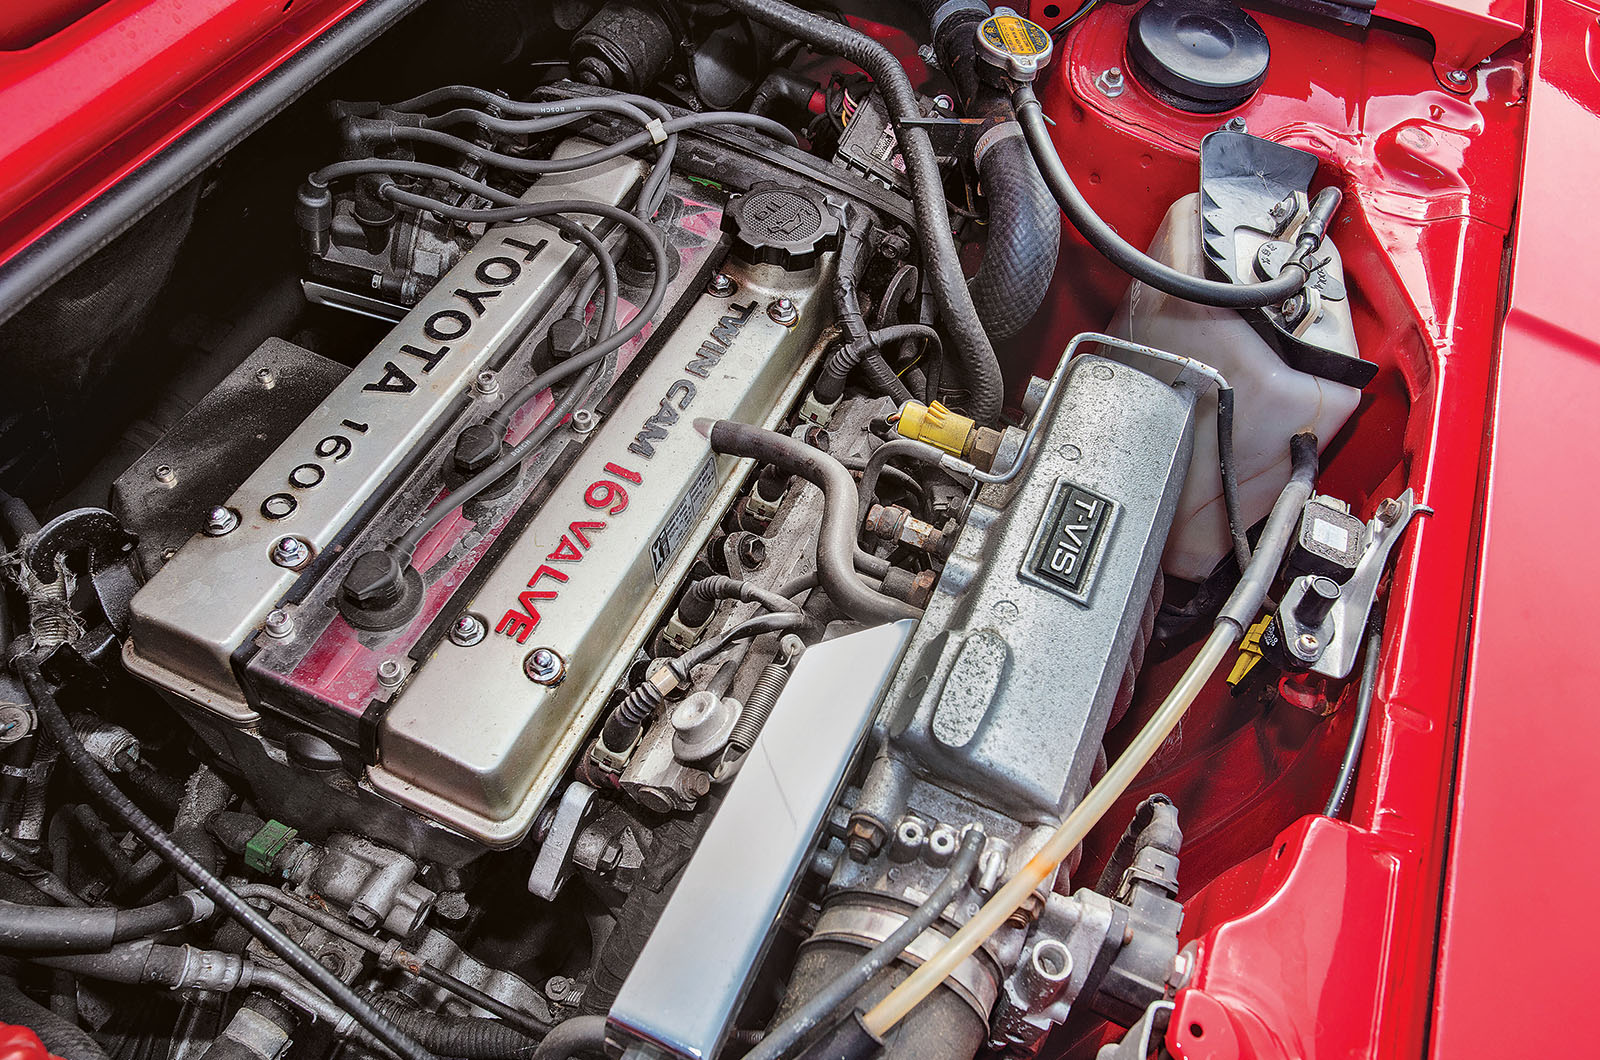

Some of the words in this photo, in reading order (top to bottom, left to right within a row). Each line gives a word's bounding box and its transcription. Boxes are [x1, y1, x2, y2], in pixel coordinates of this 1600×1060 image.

[540, 105, 566, 114] BOSCH
[754, 200, 788, 221] OIL
[362, 236, 549, 396] TOYOTA
[683, 300, 759, 380] TWIN
[627, 378, 697, 460] CAM
[259, 418, 369, 521] 1600
[583, 461, 644, 516] 16
[1050, 498, 1099, 576] T-VIS
[494, 520, 608, 645] VALVE
